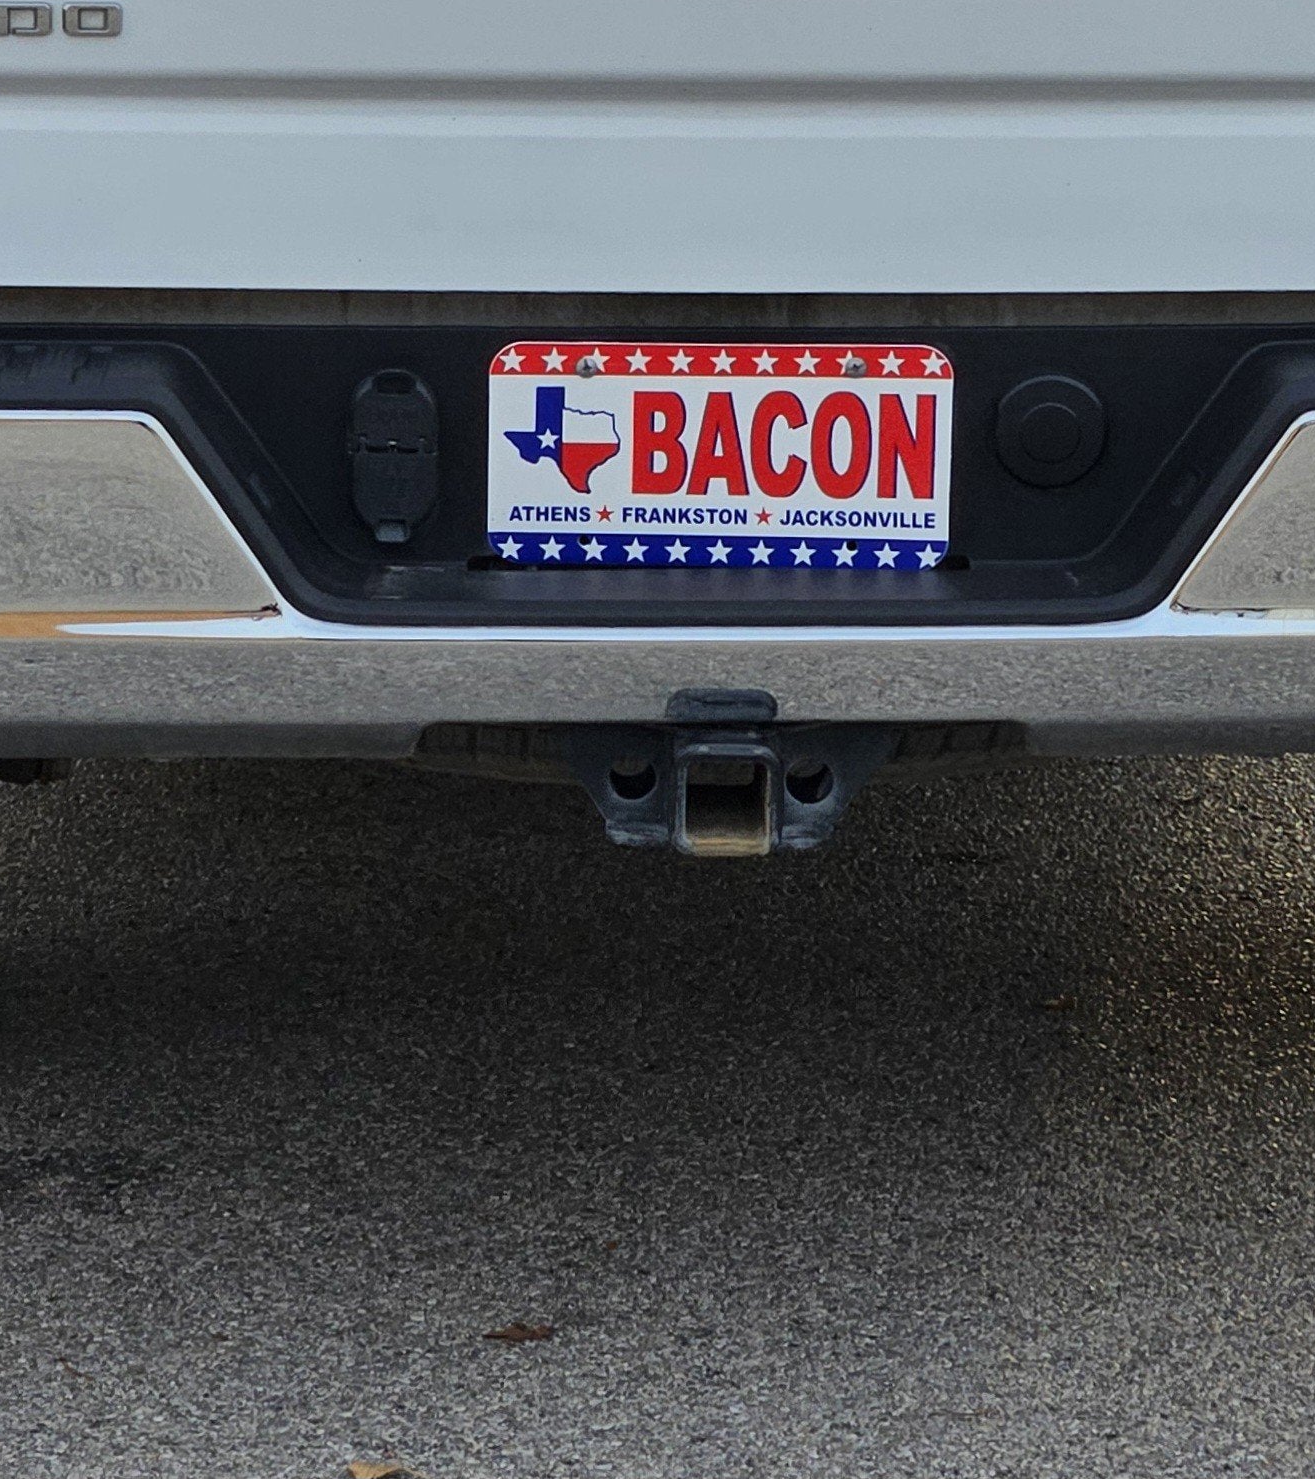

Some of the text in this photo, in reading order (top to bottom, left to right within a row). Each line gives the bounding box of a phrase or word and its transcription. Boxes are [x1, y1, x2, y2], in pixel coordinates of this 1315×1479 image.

[630, 390, 936, 500] BACON
[508, 504, 936, 529] ATHENS FRANKSTON JACKSONVILLE
